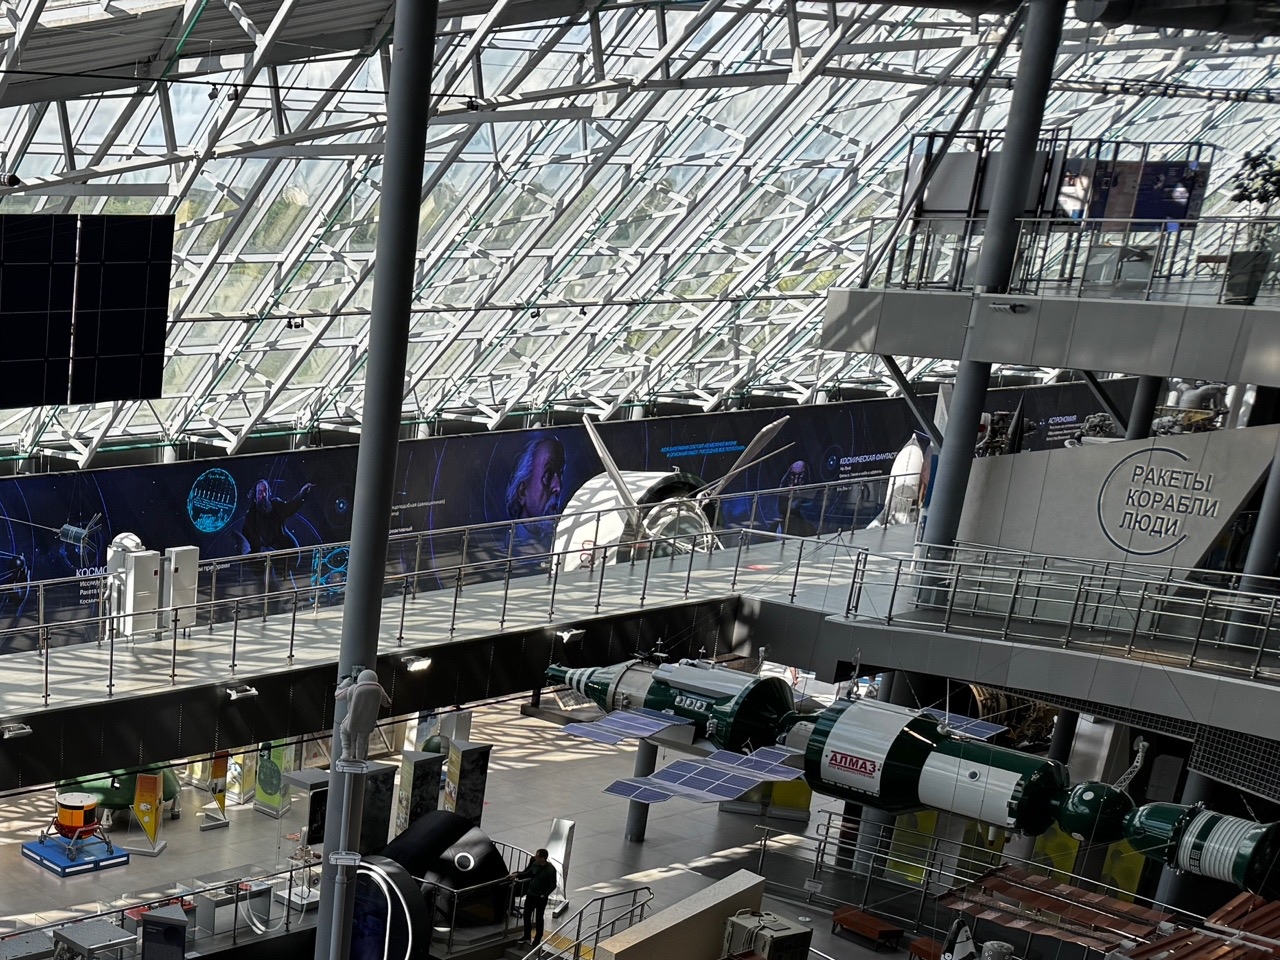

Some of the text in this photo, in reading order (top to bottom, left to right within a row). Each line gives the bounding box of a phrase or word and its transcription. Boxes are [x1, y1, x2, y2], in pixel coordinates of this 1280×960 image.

[1131, 465, 1213, 492] РАКЕТЫ
[1125, 488, 1219, 518] КОРАБЛИ
[1119, 511, 1180, 538] ЛЮДИ
[829, 752, 877, 774] АЛМАЗ
